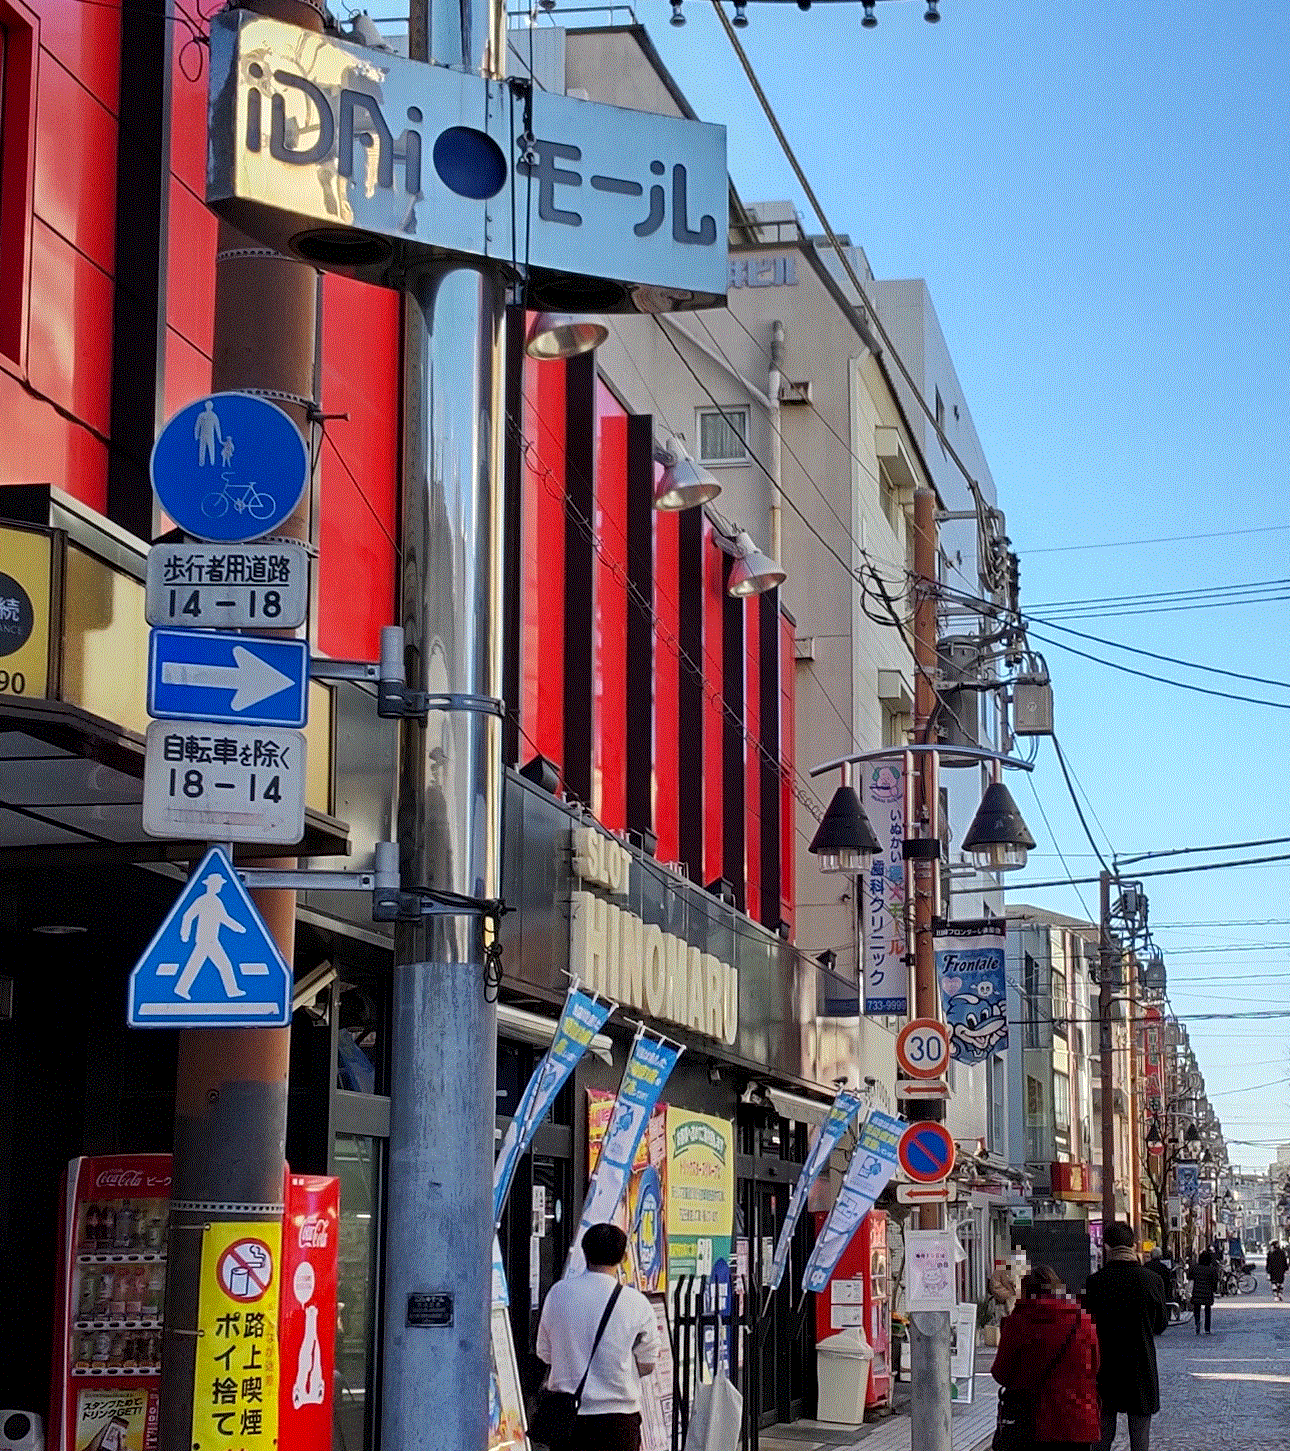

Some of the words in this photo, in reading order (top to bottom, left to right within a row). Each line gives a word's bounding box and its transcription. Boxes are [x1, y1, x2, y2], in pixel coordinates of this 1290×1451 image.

[517, 134, 717, 245] モール
[163, 554, 291, 583] 歩行者用道路
[163, 734, 291, 767] 自転車を除く
[571, 826, 634, 893] SLOT
[571, 890, 738, 1045] HINOMARU
[870, 861, 886, 987] 歯科クリニック
[942, 953, 1000, 975] Frontale
[910, 1036, 942, 1062] 30
[211, 1312, 240, 1437] ポイ捨て
[240, 1312, 265, 1436] 路上喫煙
